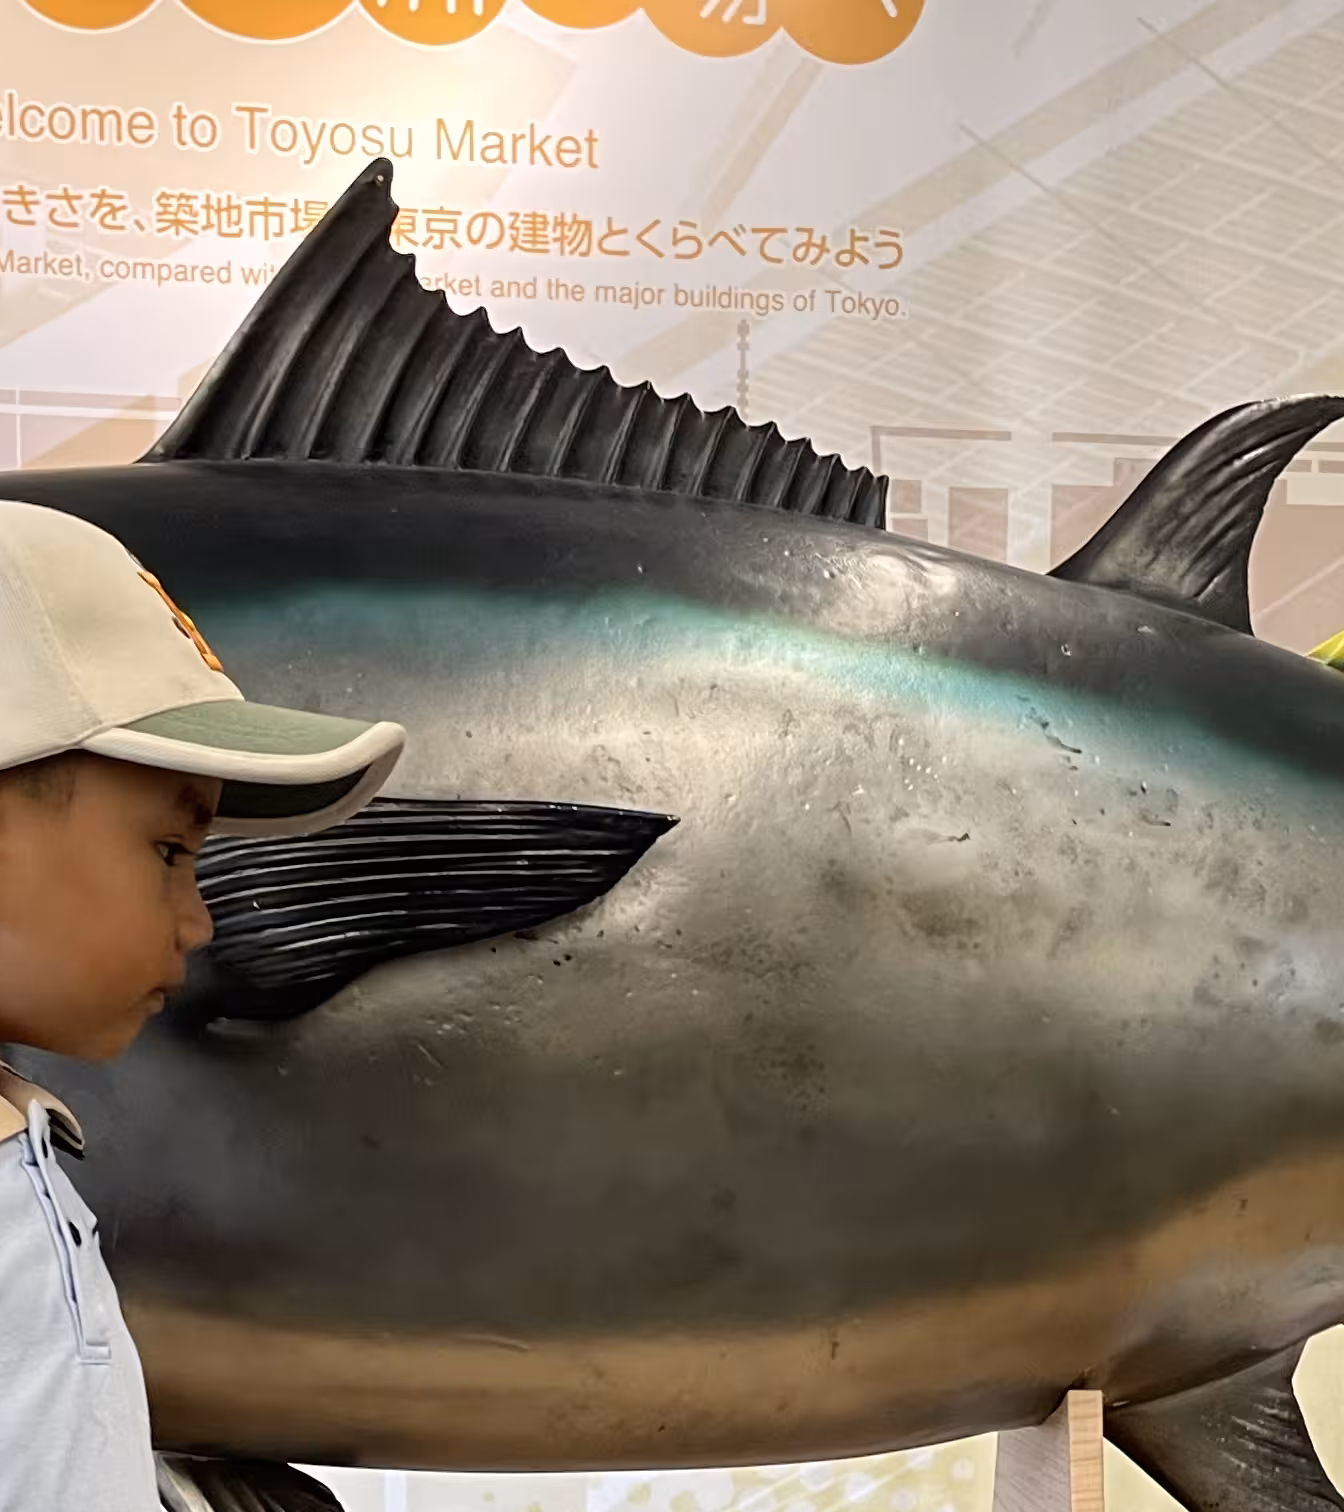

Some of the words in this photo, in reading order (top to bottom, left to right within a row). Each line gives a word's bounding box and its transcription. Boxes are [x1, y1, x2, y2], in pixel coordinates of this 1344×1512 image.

[172, 105, 218, 148] to
[235, 106, 413, 165] Toyosu
[435, 118, 599, 168] Market
[100, 260, 232, 287] compared
[491, 276, 537, 299] and
[546, 277, 585, 301] the
[595, 282, 666, 309] major
[673, 283, 785, 315] buildings
[793, 288, 817, 311] of
[824, 290, 908, 320] Tokyo.
